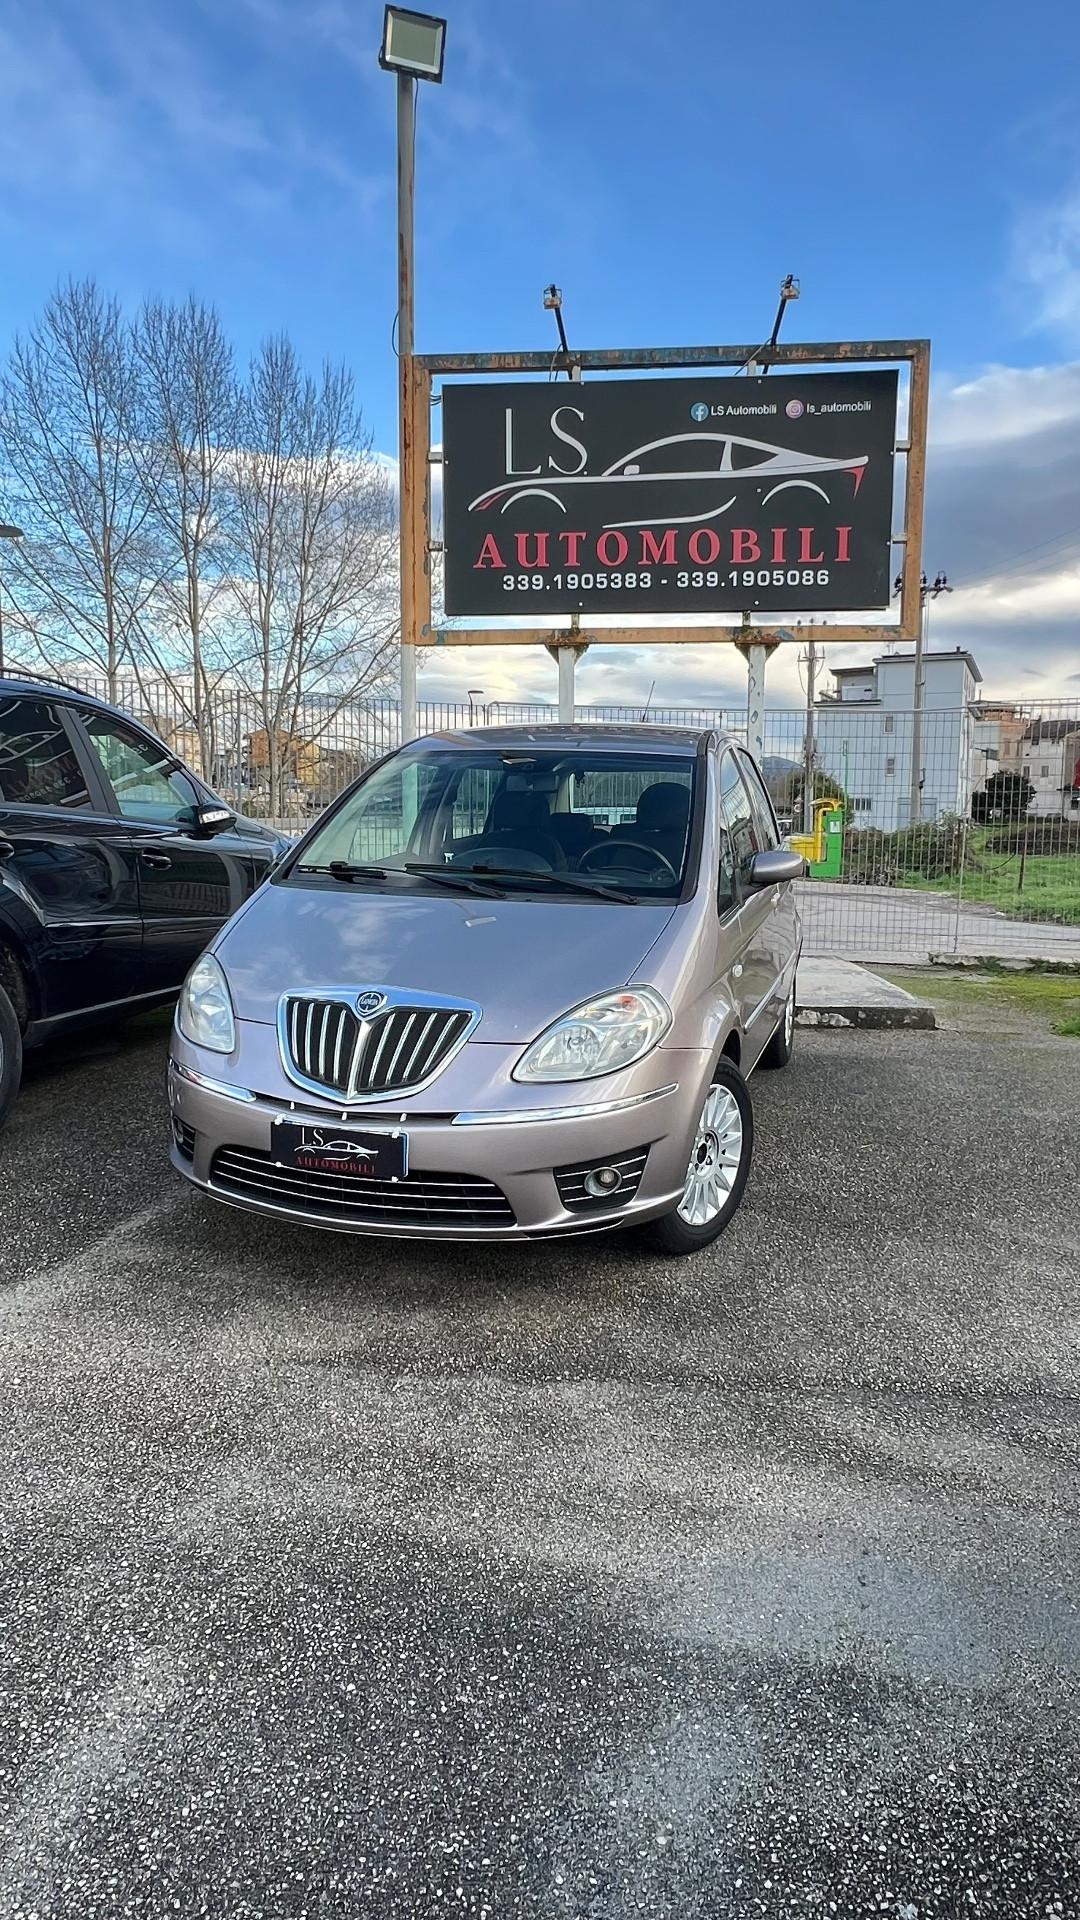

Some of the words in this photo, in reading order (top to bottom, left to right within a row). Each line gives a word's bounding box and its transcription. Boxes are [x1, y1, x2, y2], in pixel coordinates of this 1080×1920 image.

[711, 405, 724, 416] LS
[726, 403, 777, 416] Automobili
[806, 401, 872, 415] ls_automobili
[472, 526, 853, 569] AUTOMOBILI
[502, 572, 652, 591] 339.1905383
[676, 569, 830, 588] 339.1905086
[297, 1156, 376, 1175] AUTOMOBILI
